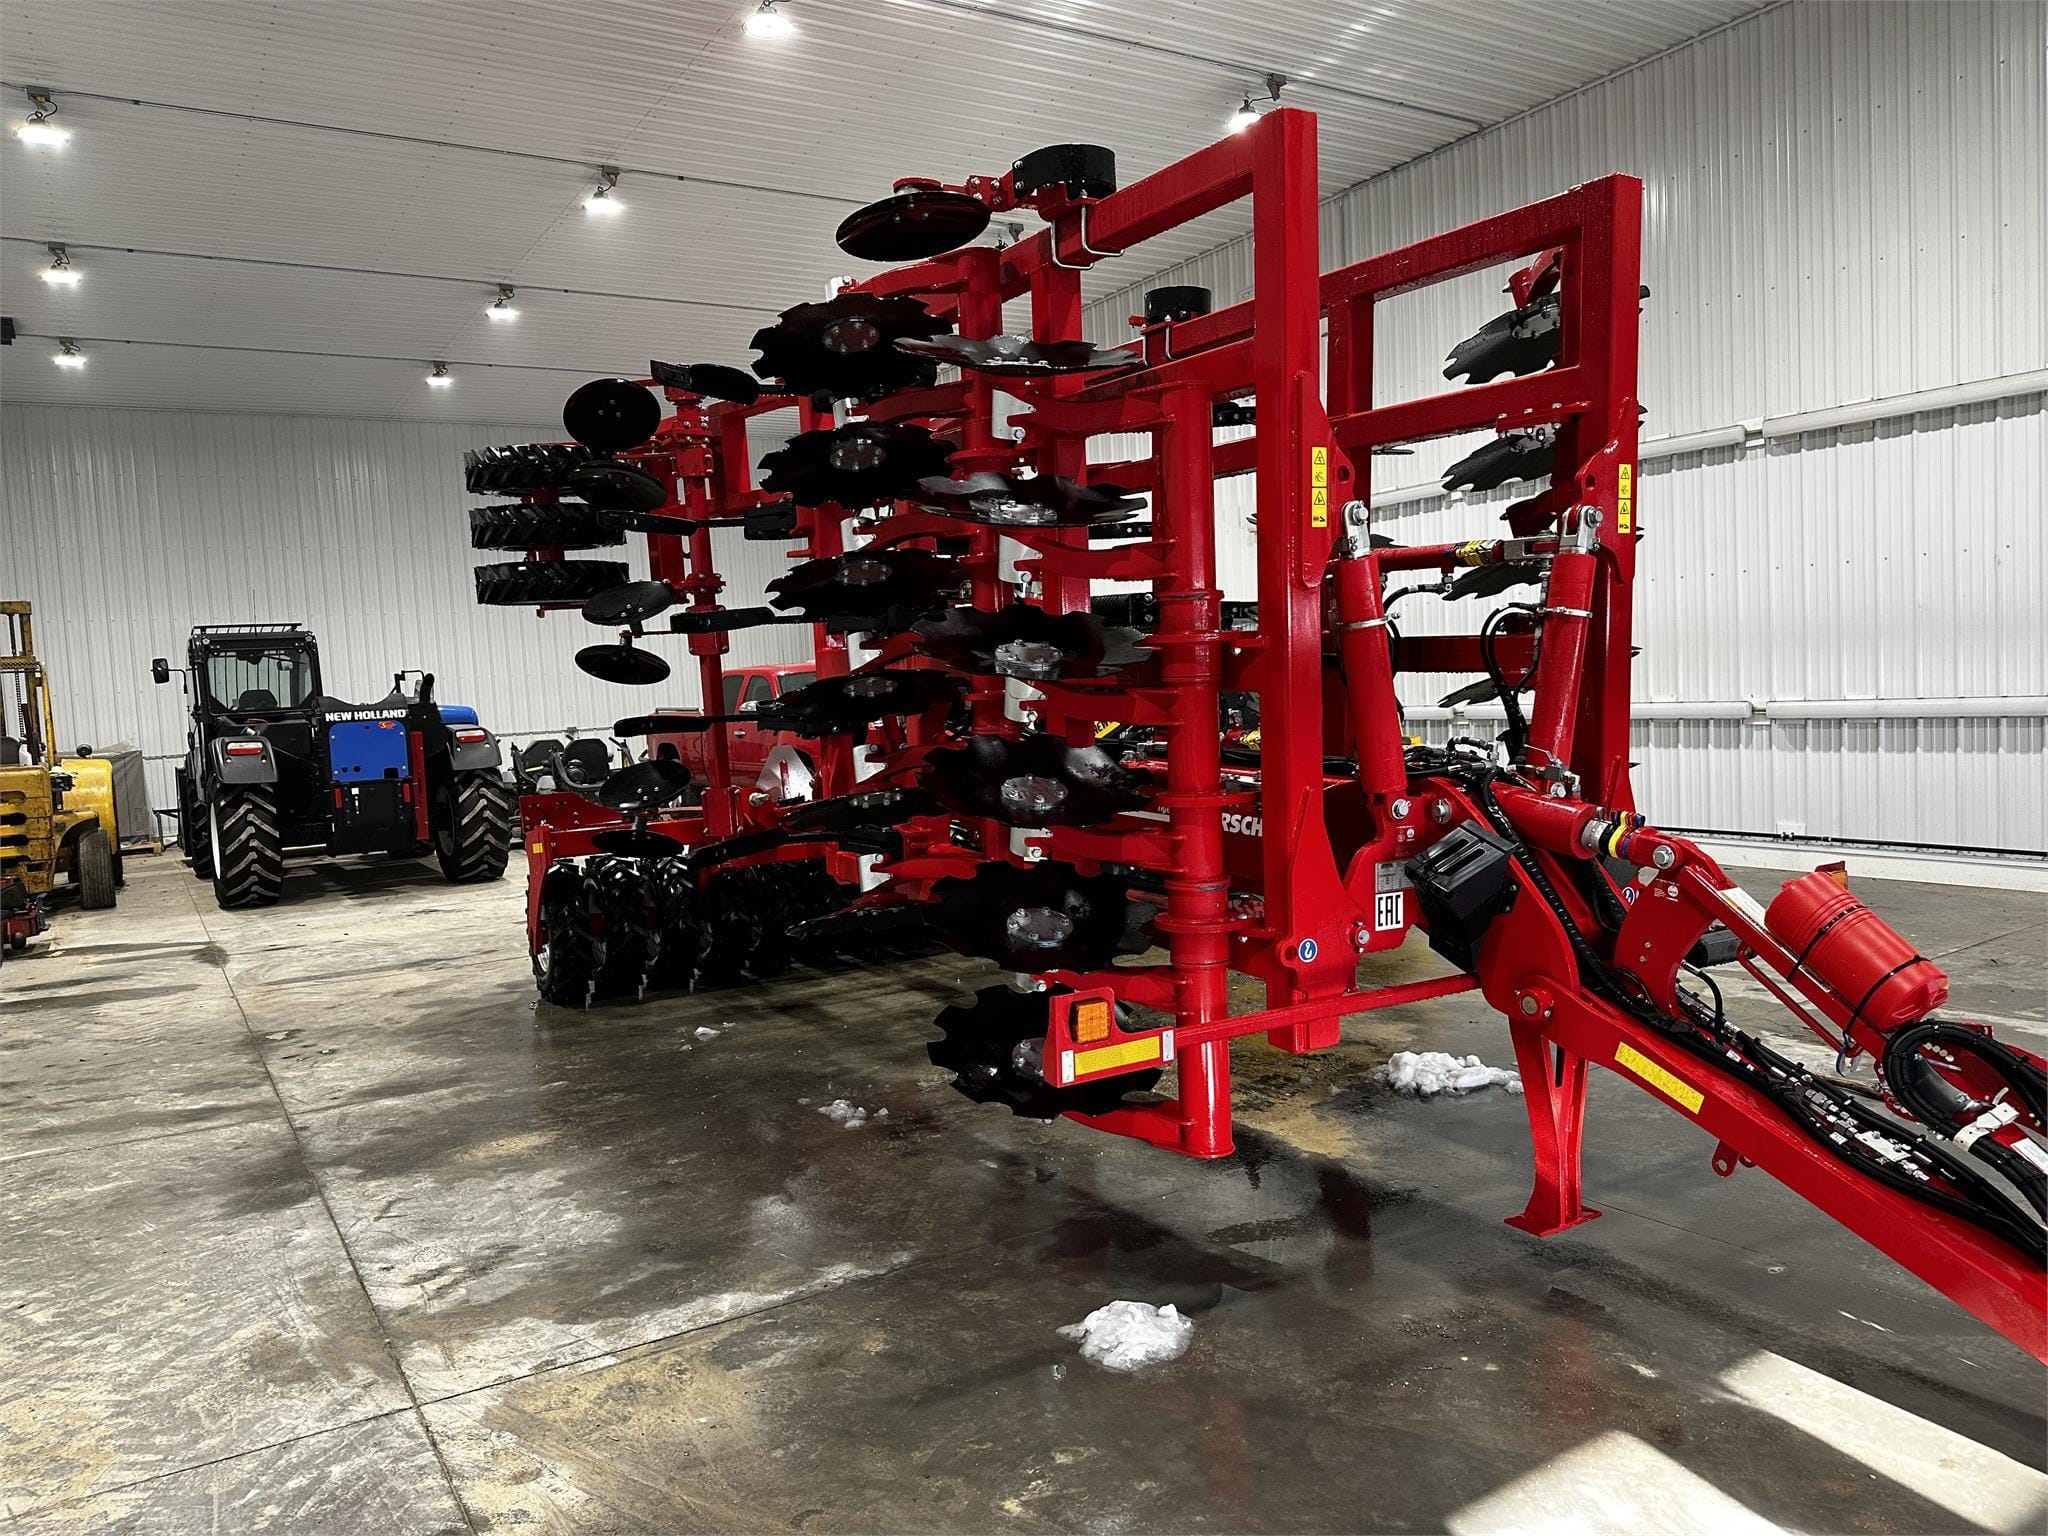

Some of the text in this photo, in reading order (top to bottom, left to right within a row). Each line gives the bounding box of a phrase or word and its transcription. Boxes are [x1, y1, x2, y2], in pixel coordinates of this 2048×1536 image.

[325, 709, 406, 722] NEW HOLLAND
[1378, 894, 1401, 927] EAC
